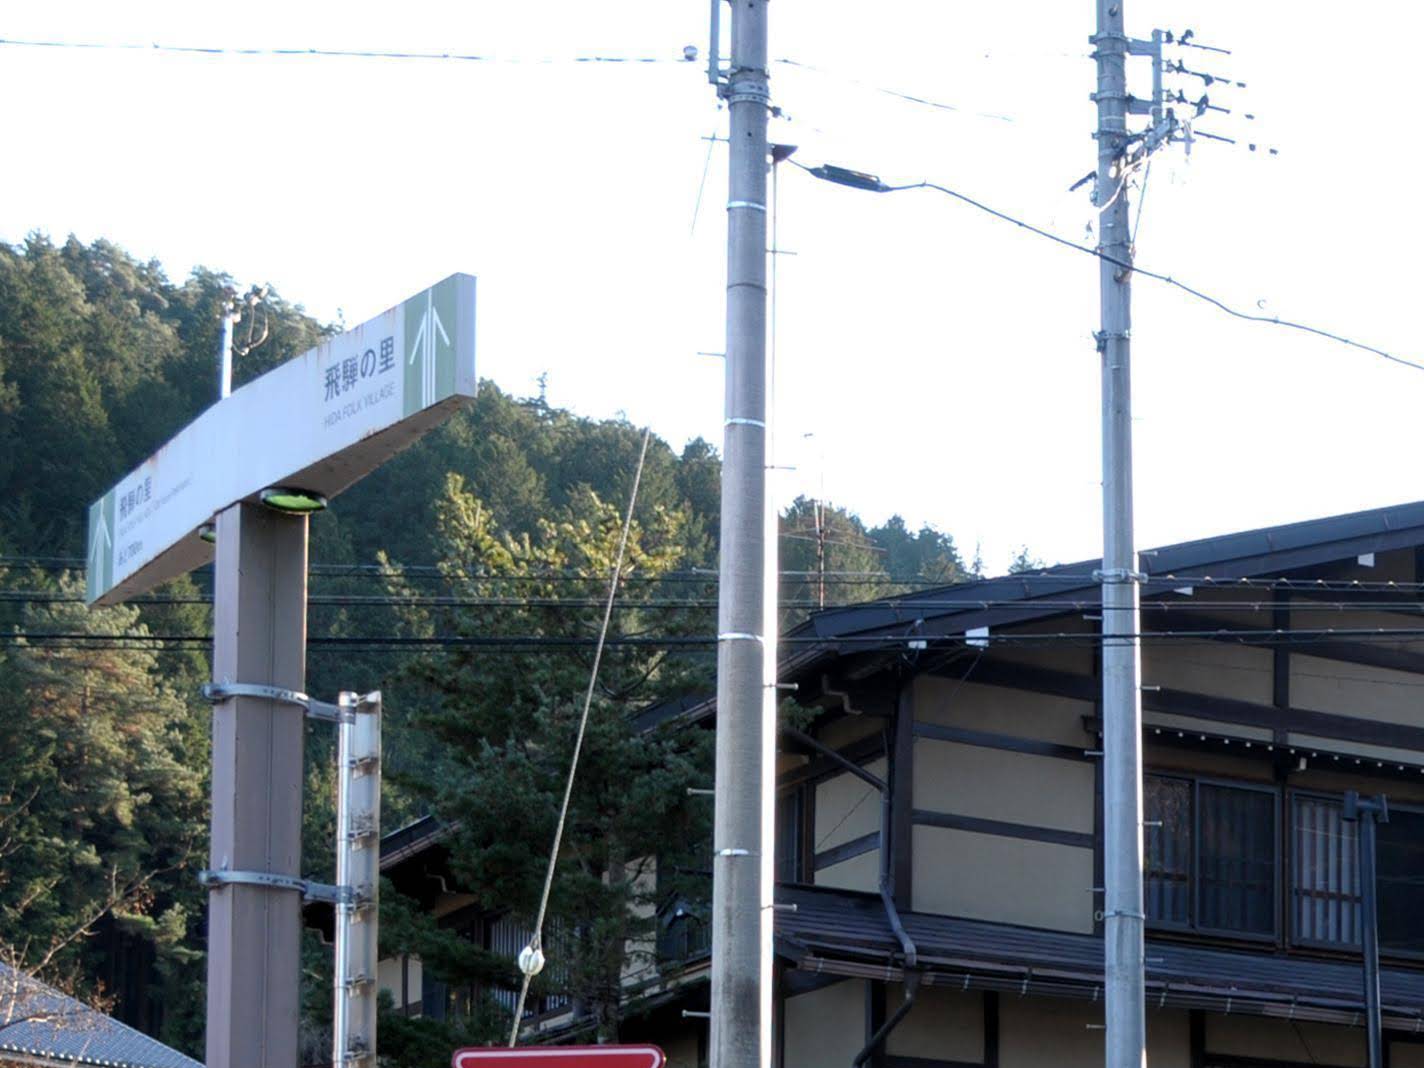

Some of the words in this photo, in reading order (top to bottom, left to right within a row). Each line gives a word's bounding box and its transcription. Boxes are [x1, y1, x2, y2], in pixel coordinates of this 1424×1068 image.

[324, 335, 395, 402] 飛騨の里
[324, 409, 342, 429] HIDA
[343, 399, 362, 418] FOLK
[363, 382, 395, 407] VILLAGE
